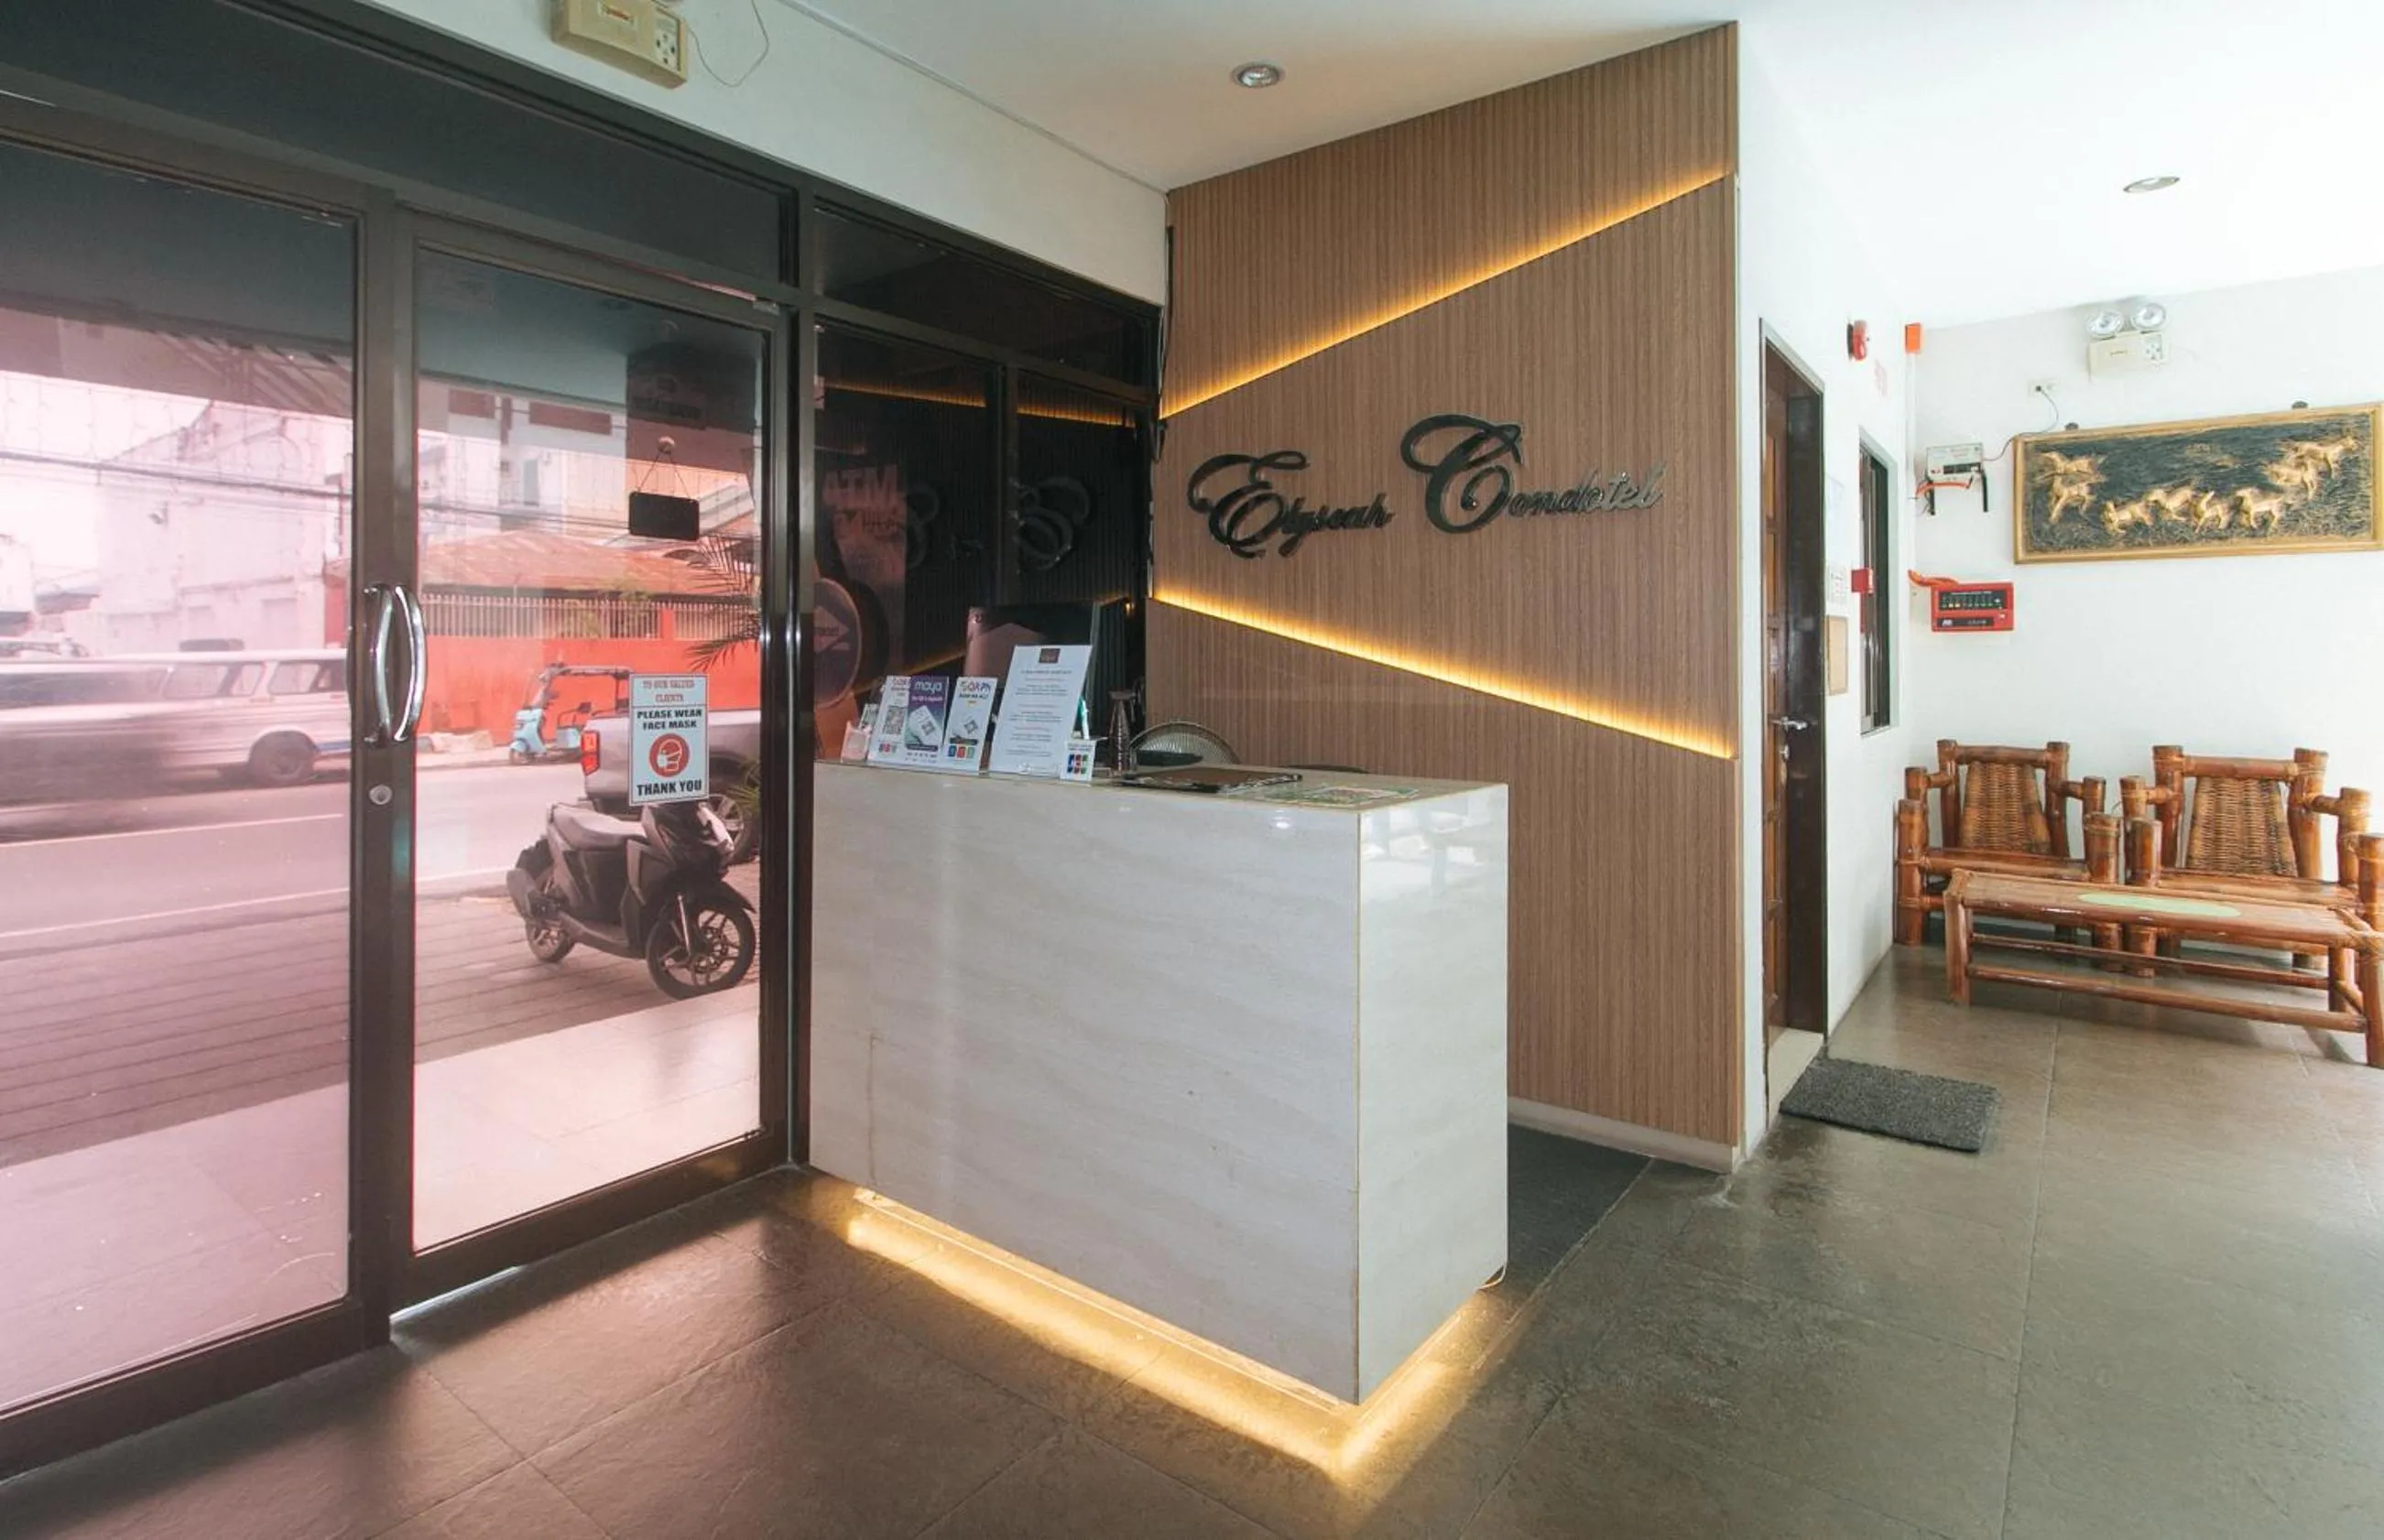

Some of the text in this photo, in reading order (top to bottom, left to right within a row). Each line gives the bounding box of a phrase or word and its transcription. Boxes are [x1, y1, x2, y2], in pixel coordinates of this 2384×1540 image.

[915, 681, 942, 694] maya
[637, 708, 702, 720] PLEASE WEAR
[643, 720, 697, 731] FACE MASK
[637, 779, 702, 797] THANK YOU
